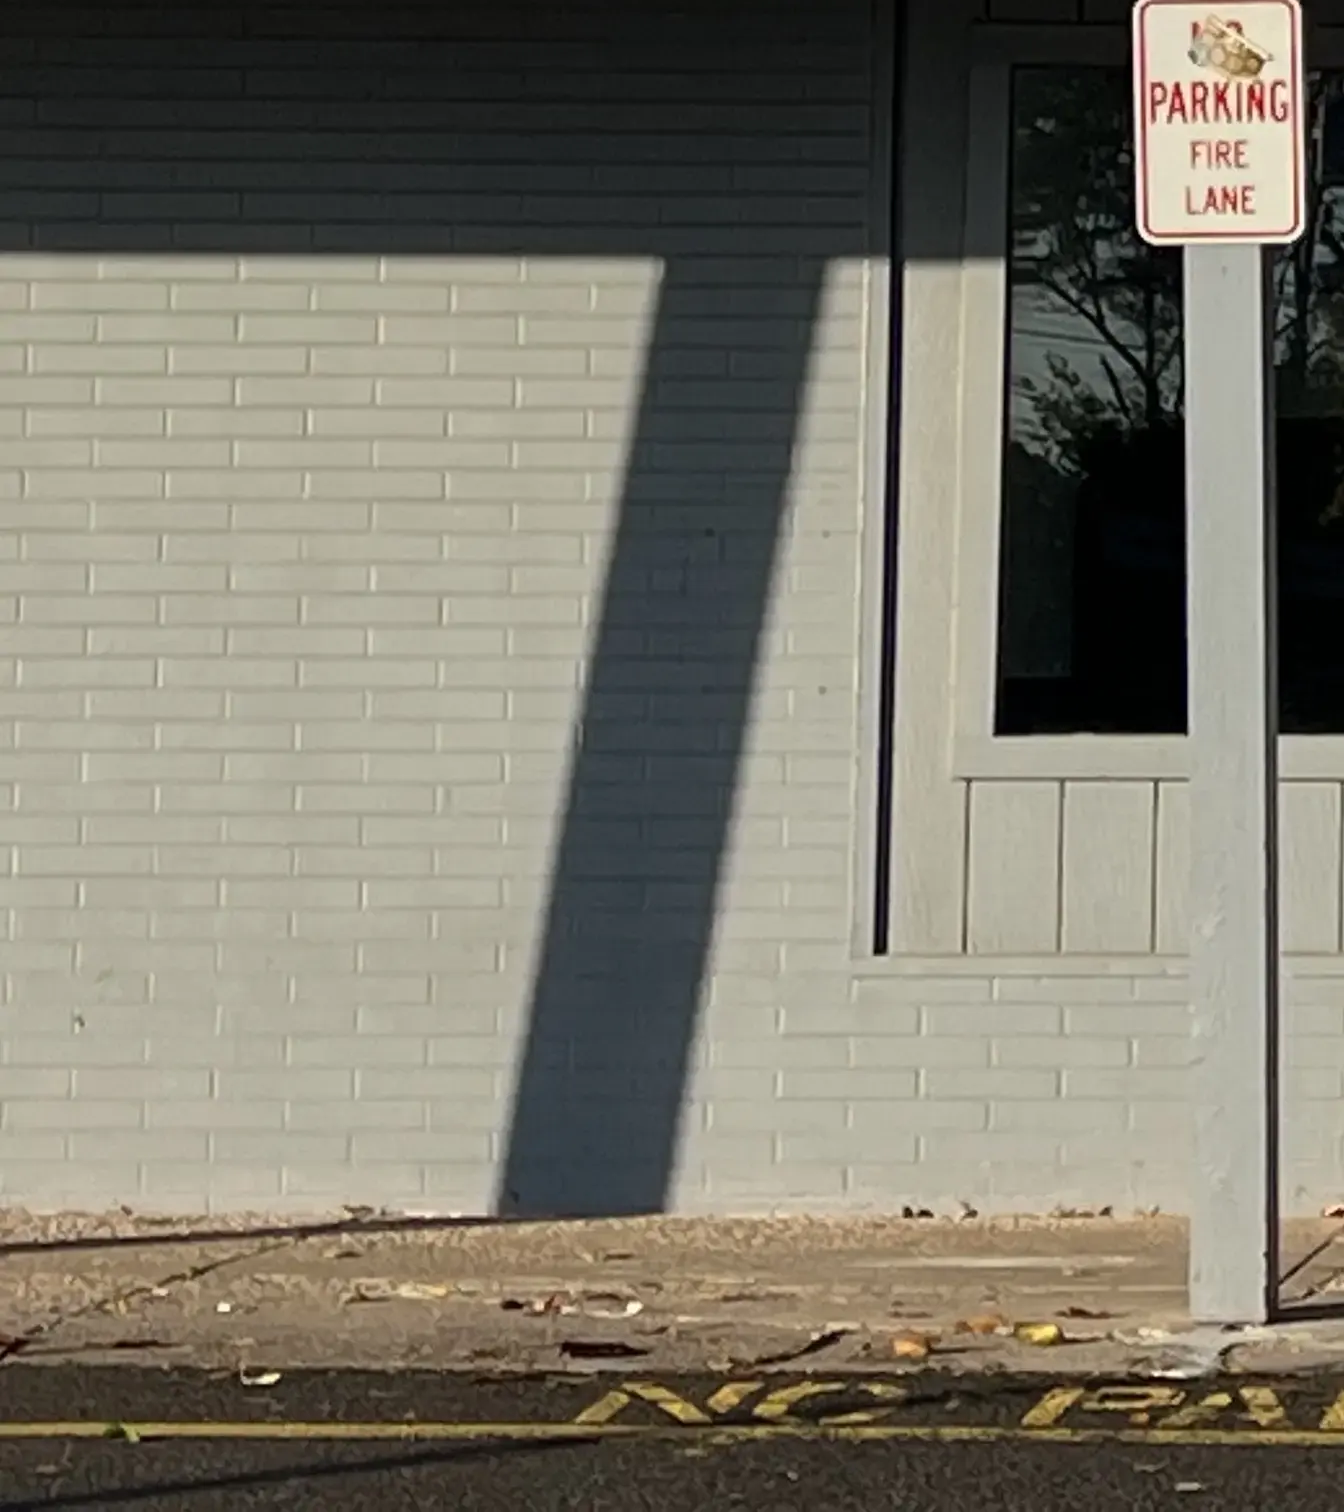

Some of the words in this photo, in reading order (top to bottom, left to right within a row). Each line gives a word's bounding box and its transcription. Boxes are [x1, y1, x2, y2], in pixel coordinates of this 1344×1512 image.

[1149, 80, 1290, 124] PARKING
[1190, 140, 1249, 170] FIRE
[1184, 185, 1256, 216] LANE
